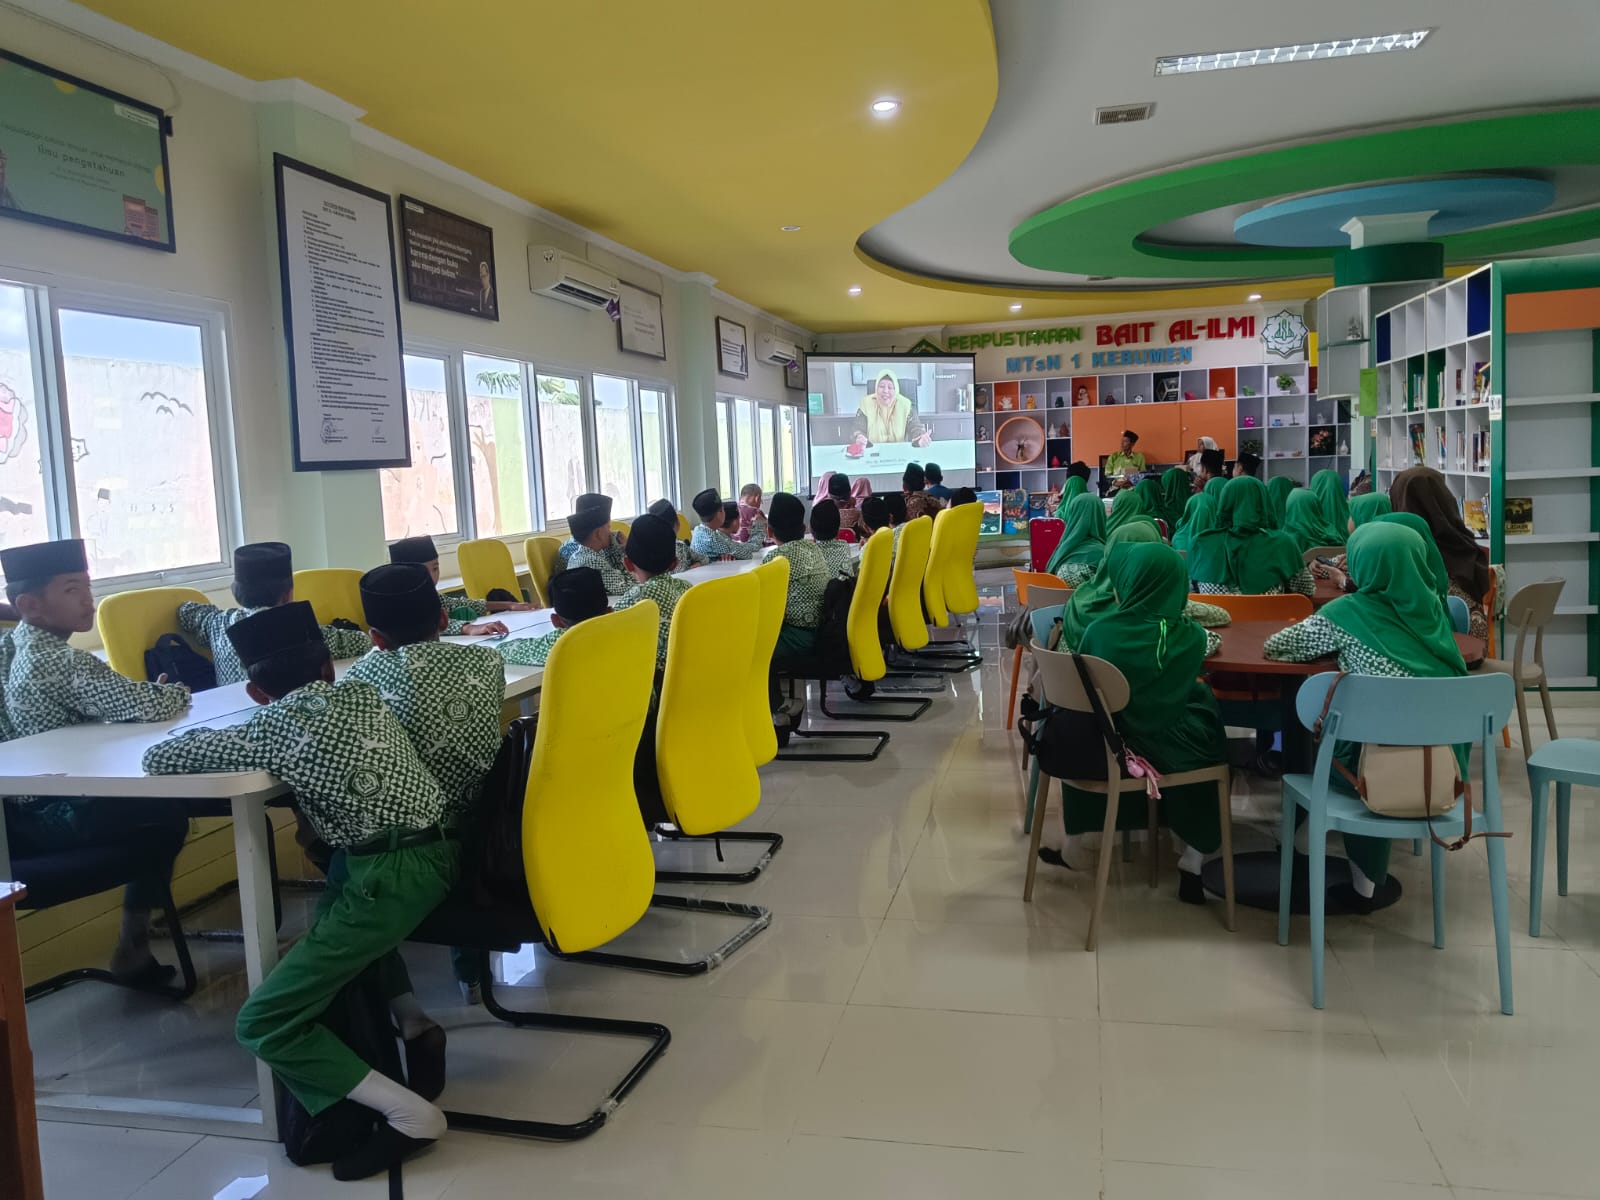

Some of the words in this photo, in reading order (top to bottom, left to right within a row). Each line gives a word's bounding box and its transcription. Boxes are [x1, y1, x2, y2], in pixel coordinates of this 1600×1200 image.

[948, 326, 1081, 350] PERPUSTAKAAN
[1096, 322, 1155, 347] BAIT
[1168, 315, 1255, 344] AL-ILMI
[1006, 354, 1061, 374] MTsN
[1071, 353, 1081, 369] 1
[1092, 346, 1193, 369] KEBUMEN
